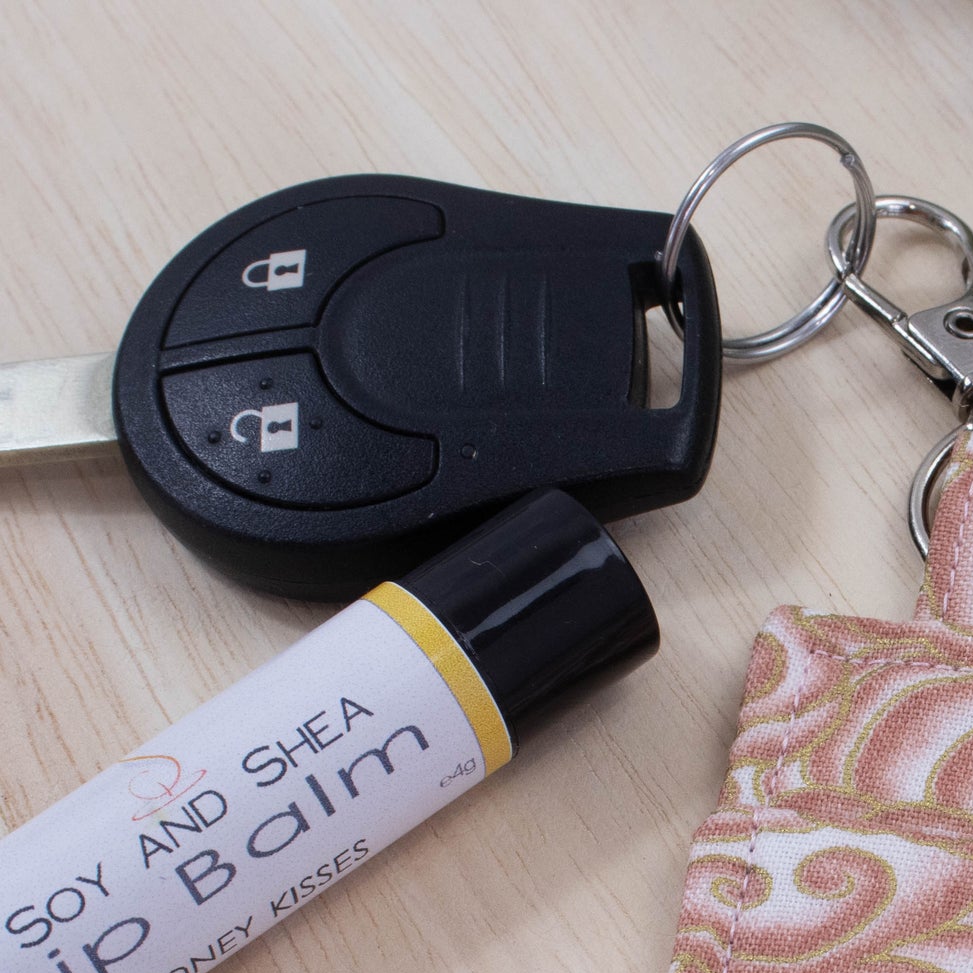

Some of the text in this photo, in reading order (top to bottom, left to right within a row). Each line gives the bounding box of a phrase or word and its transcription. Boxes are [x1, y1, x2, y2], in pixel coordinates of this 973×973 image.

[5, 696, 374, 949] SOY AND SHEA
[174, 723, 430, 906] Balm
[270, 838, 370, 918] KISSES
